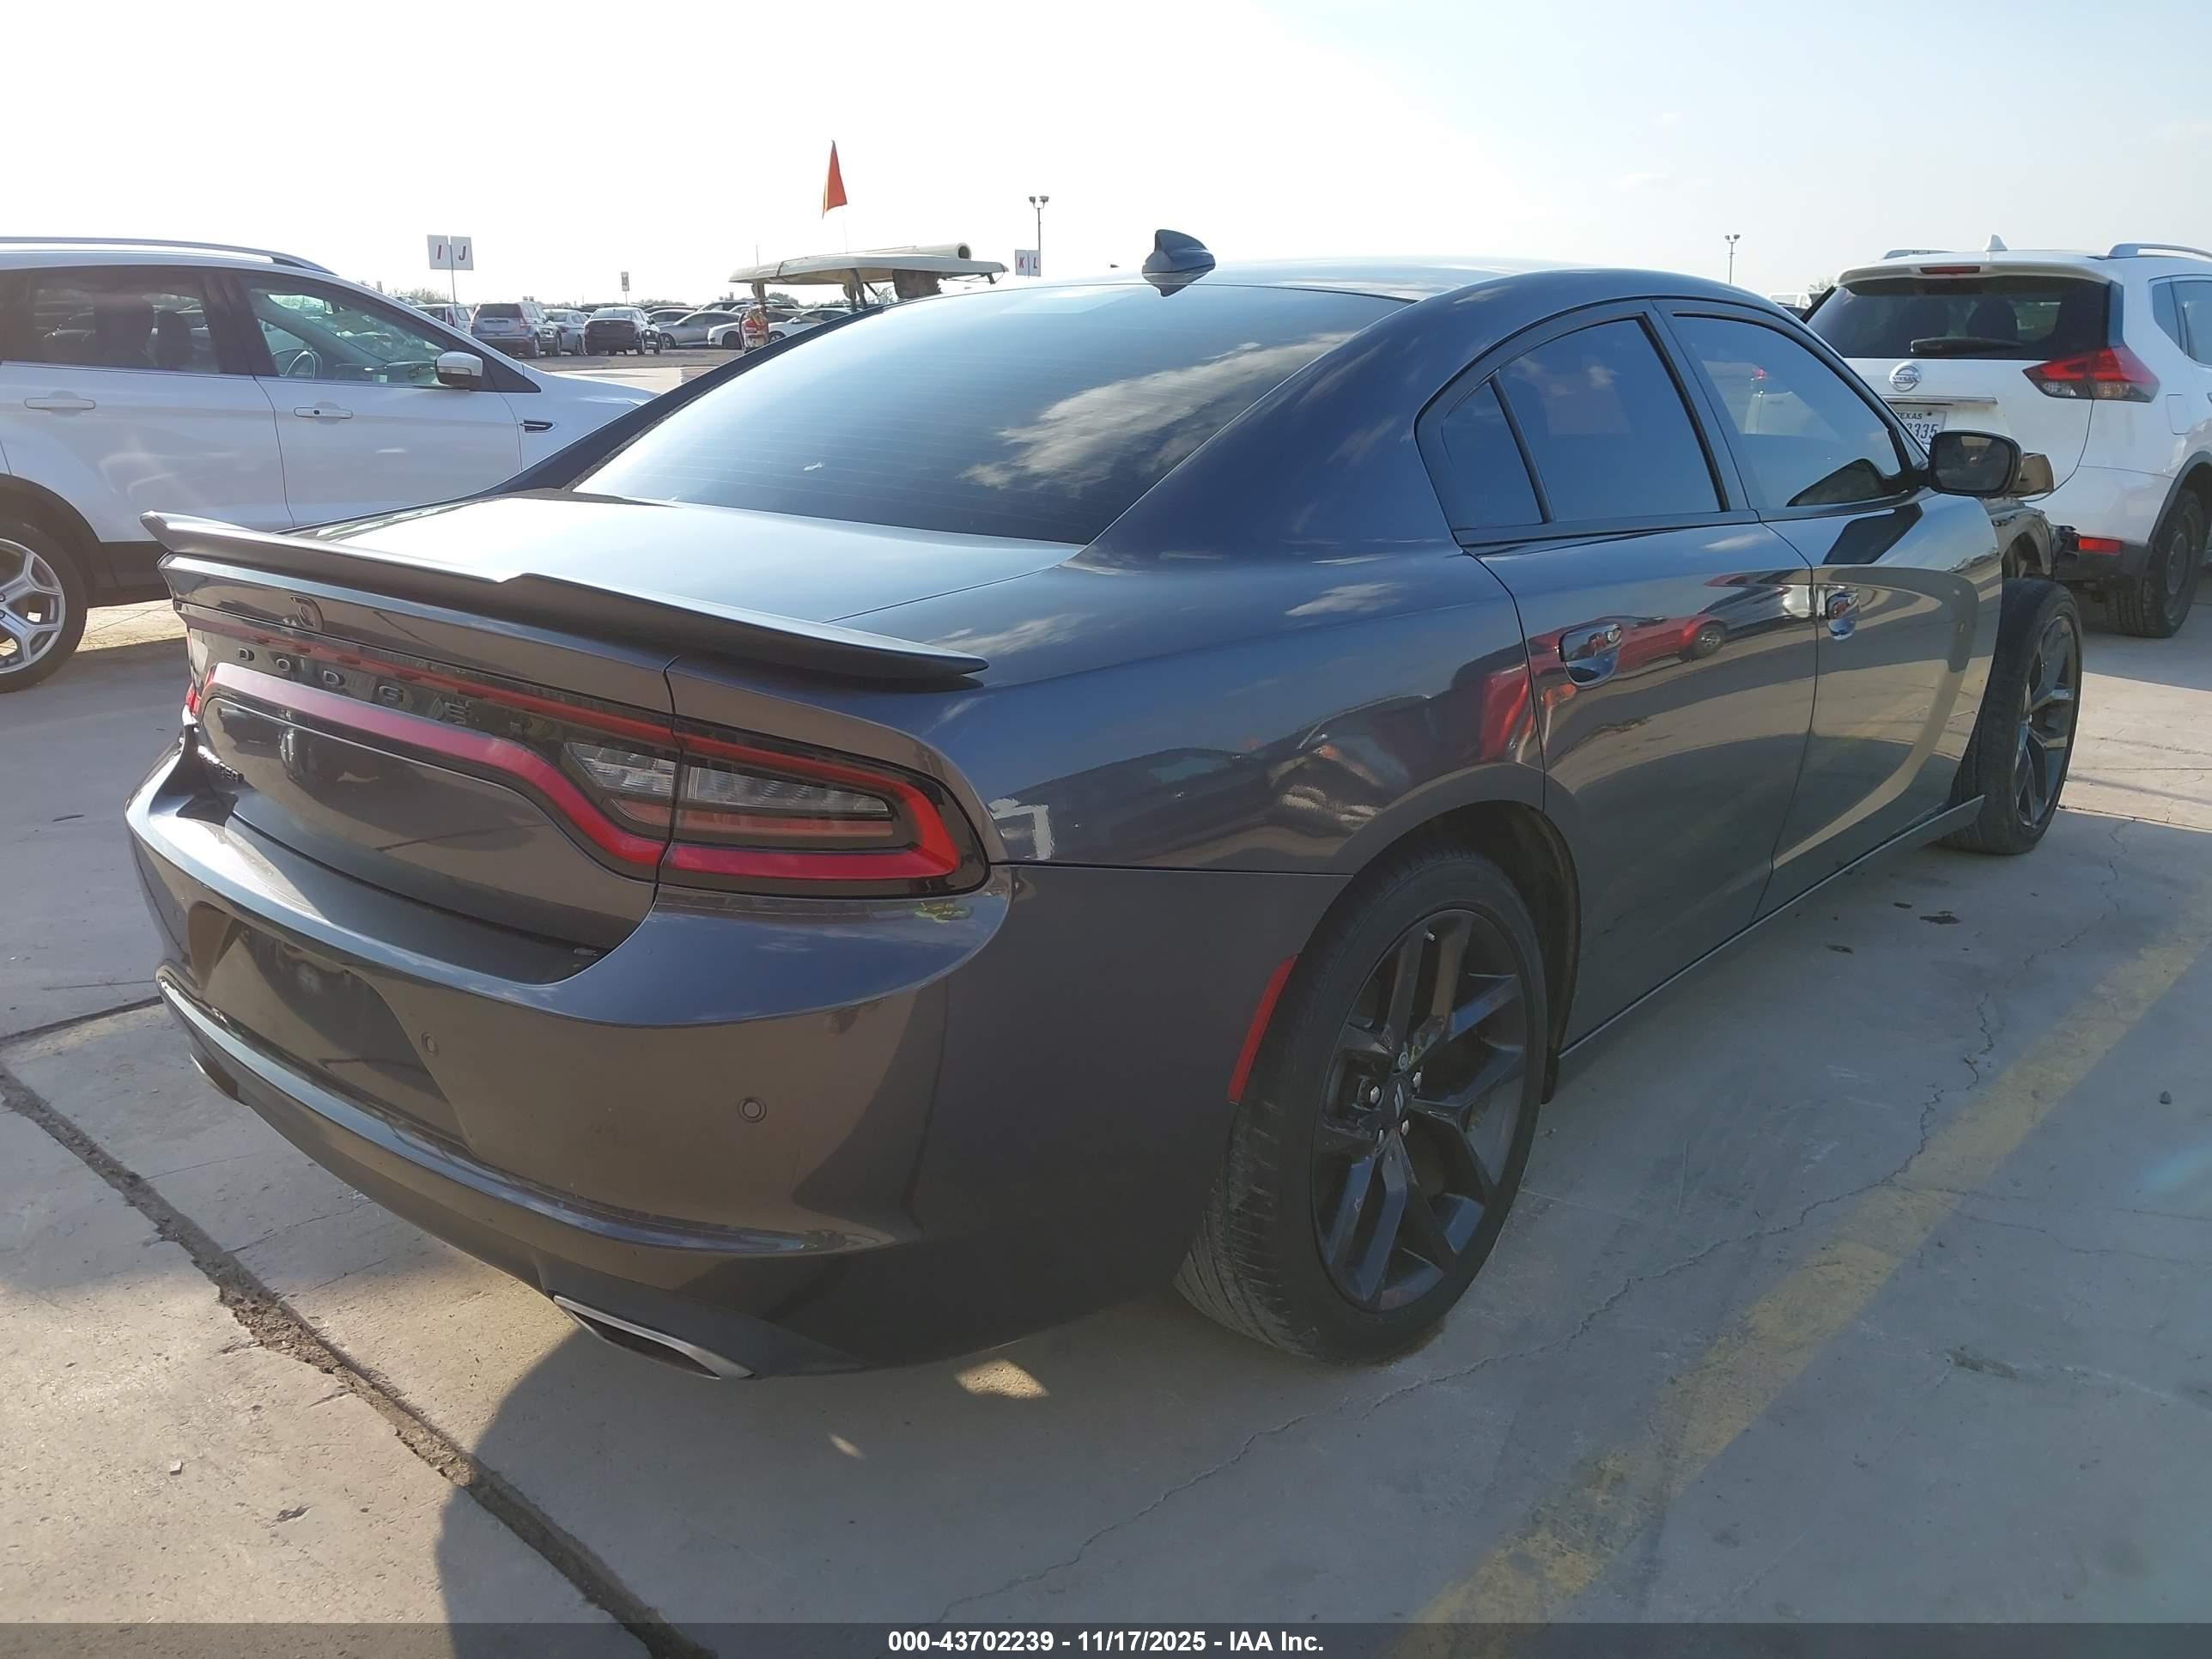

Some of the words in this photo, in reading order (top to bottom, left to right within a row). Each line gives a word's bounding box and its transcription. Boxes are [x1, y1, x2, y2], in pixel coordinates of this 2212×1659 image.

[437, 244, 442, 260] I
[458, 246, 466, 261] J
[1019, 256, 1025, 268] K
[1033, 257, 1037, 269] L
[238, 647, 469, 725] DODGE
